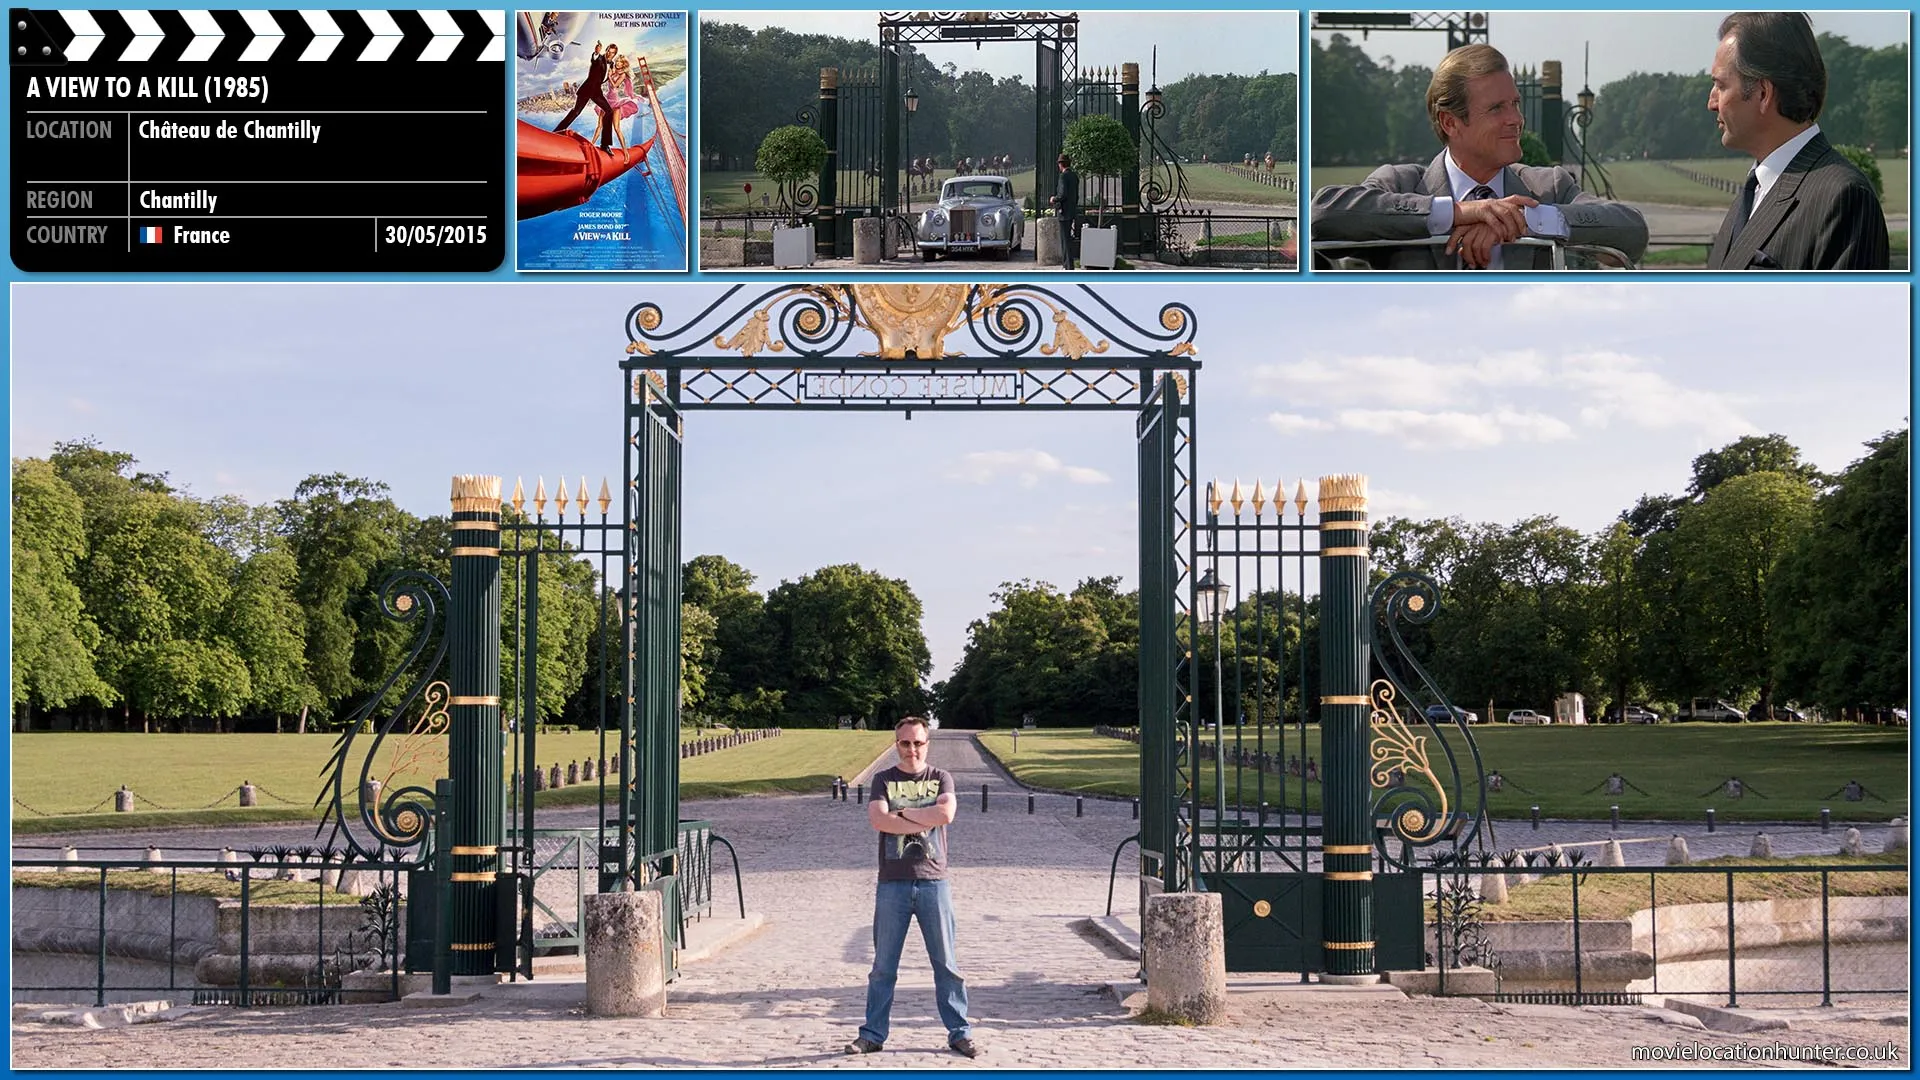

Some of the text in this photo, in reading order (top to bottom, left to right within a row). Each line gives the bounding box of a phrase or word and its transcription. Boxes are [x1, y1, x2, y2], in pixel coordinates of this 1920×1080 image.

[613, 12, 634, 20] JAMES
[579, 232, 600, 240] VIEW
[612, 232, 631, 240] KILL
[887, 780, 940, 800] JAWS
